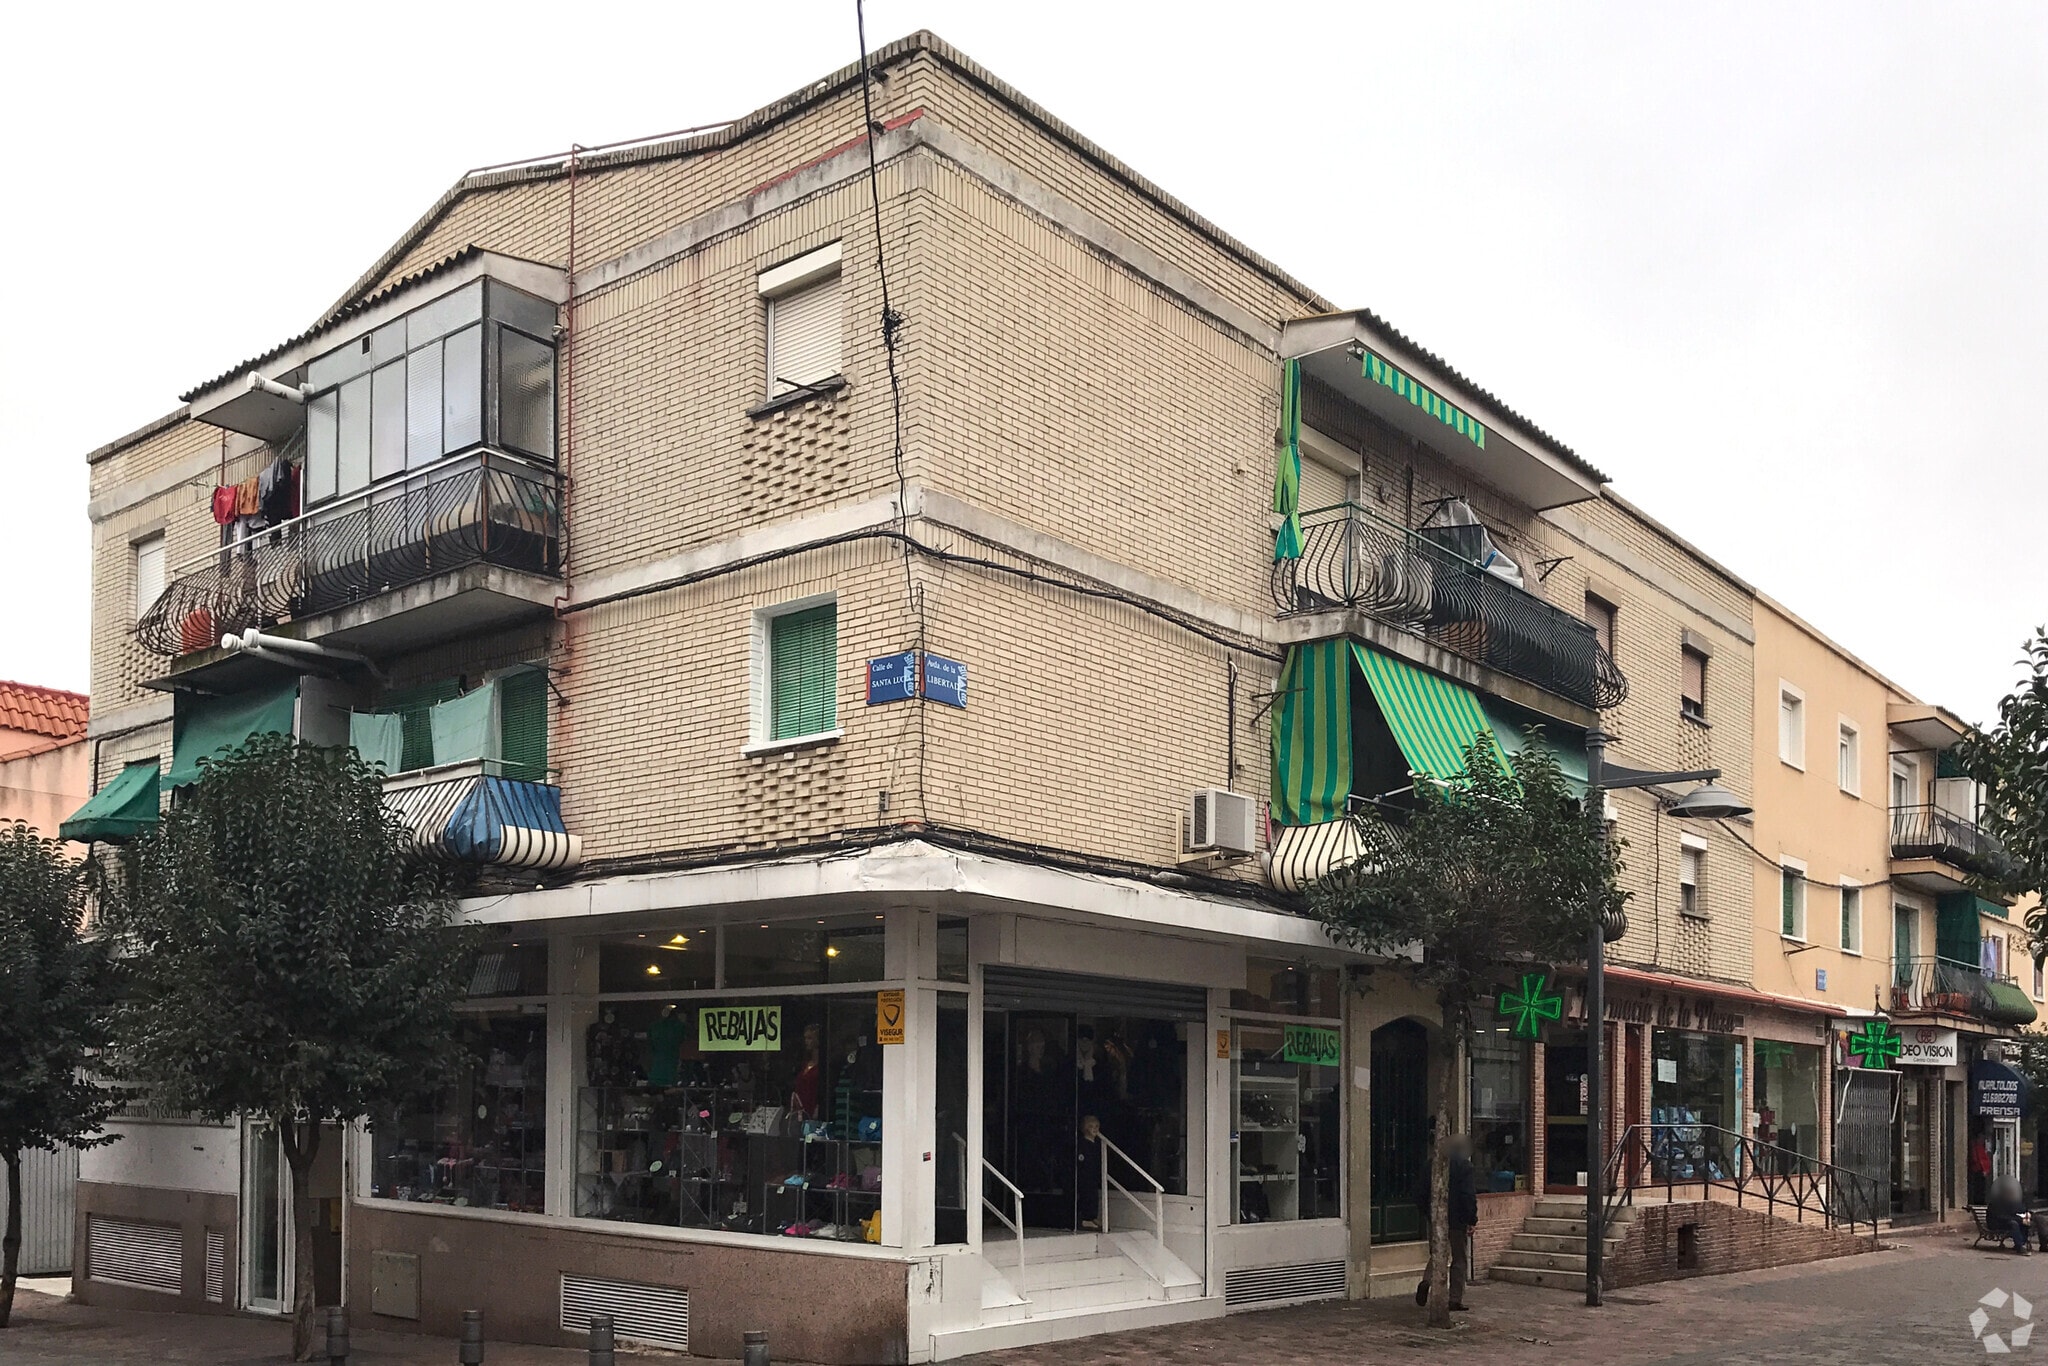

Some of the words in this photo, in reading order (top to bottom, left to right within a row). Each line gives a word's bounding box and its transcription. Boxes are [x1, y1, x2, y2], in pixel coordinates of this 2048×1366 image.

[872, 663, 885, 672] Calle
[942, 663, 950, 672] de
[950, 665, 956, 674] la
[871, 678, 892, 688] SANTA
[926, 675, 960, 690] LIBERTAD
[1657, 993, 1674, 1026] de
[1677, 996, 1691, 1028] la
[1694, 997, 1735, 1033] Plaza
[704, 1009, 778, 1046] REBAJAS
[880, 1028, 903, 1036] VISEGUR
[1286, 1031, 1336, 1062] REBAJAS
